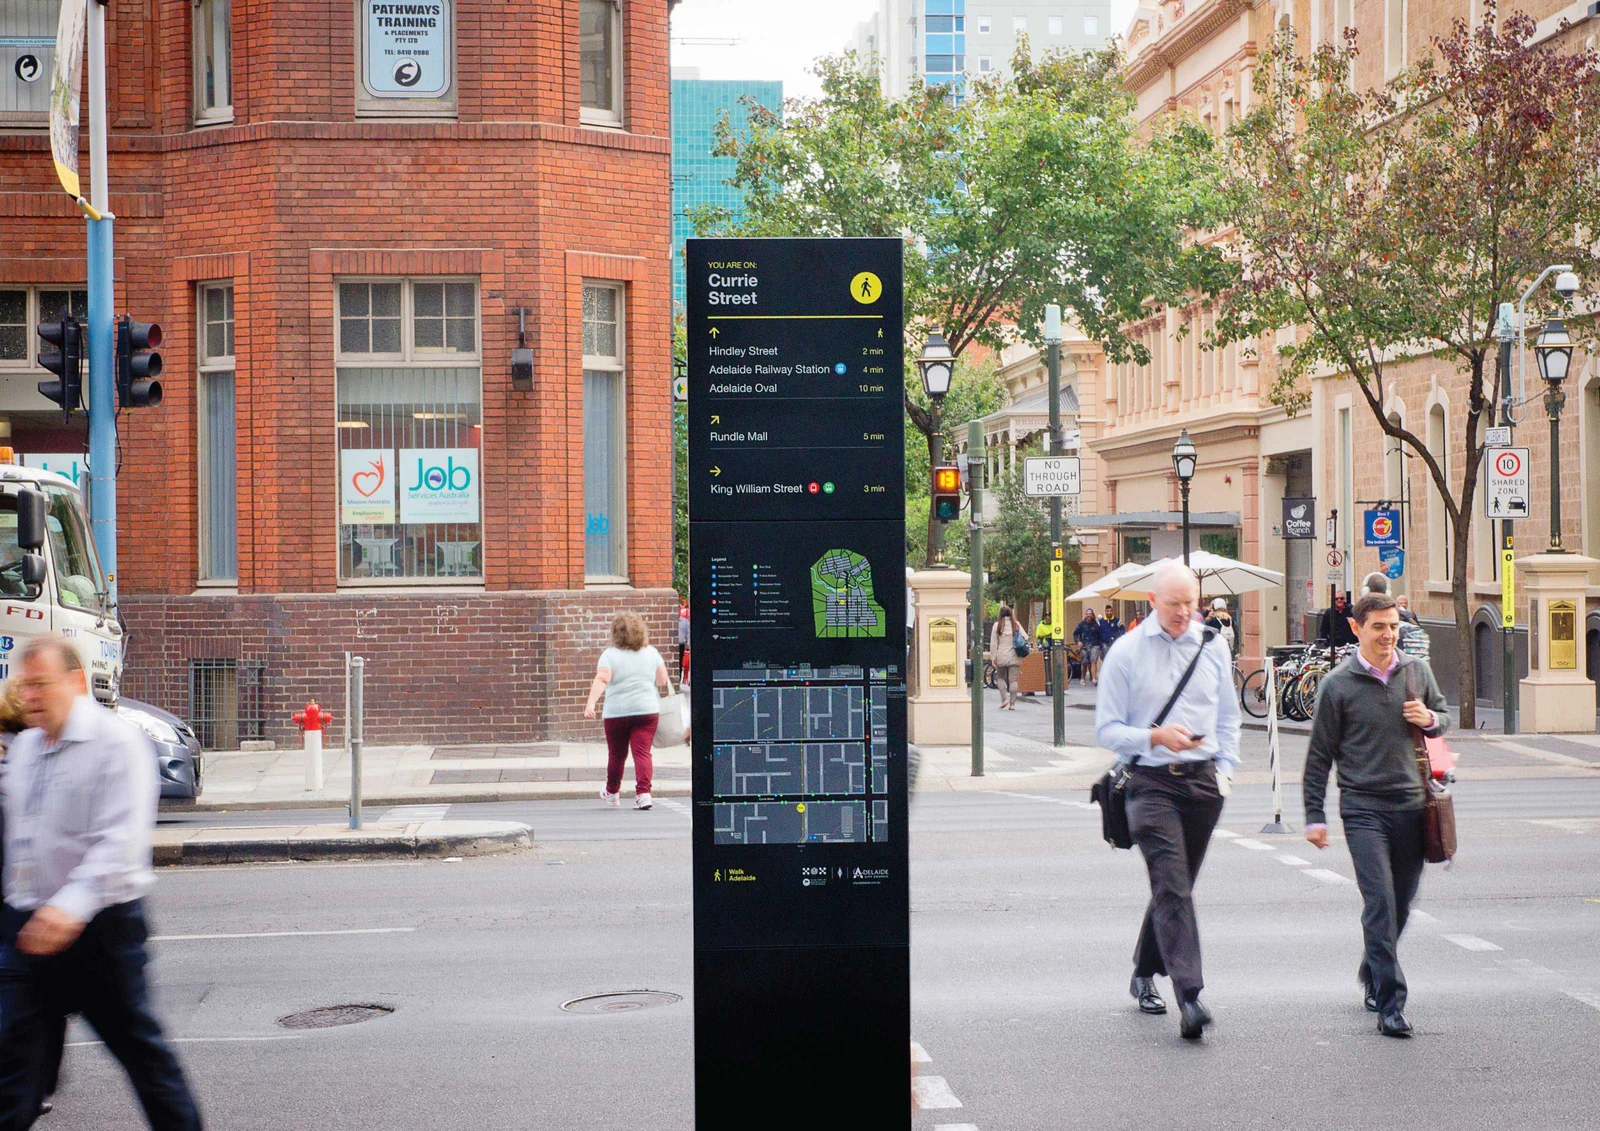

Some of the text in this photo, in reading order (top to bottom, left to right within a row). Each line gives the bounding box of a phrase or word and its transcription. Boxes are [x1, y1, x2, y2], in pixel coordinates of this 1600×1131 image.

[372, 4, 440, 15] PATHWAYS
[377, 17, 436, 28] TRAINING
[708, 261, 757, 269] YOU ARE ON:
[708, 273, 758, 288] Currie
[708, 291, 758, 305] Street
[709, 346, 778, 358] Hindley Street
[862, 347, 884, 355] 2 min
[709, 364, 830, 376] Adelaide Railway Station
[862, 366, 884, 374] 4 min
[709, 383, 777, 393] Adelaide Oval
[859, 384, 884, 392] 10 min
[710, 431, 768, 442] Rundle Mall
[863, 432, 885, 440] 5 min
[1044, 460, 1061, 469] NO
[1502, 459, 1514, 470] 10
[408, 456, 471, 491] Job
[1030, 471, 1077, 481] THROUGH
[940, 471, 955, 488] 13
[710, 483, 803, 496] King William Street
[863, 484, 885, 493] 3 min
[1036, 483, 1070, 492] ROAD
[407, 491, 470, 500] Services Australia
[586, 512, 609, 531] Job
[1286, 519, 1311, 528] Coffee
[6, 605, 44, 620] FD
[91, 659, 108, 670] HINO
[852, 866, 889, 879] ADELAIDE
